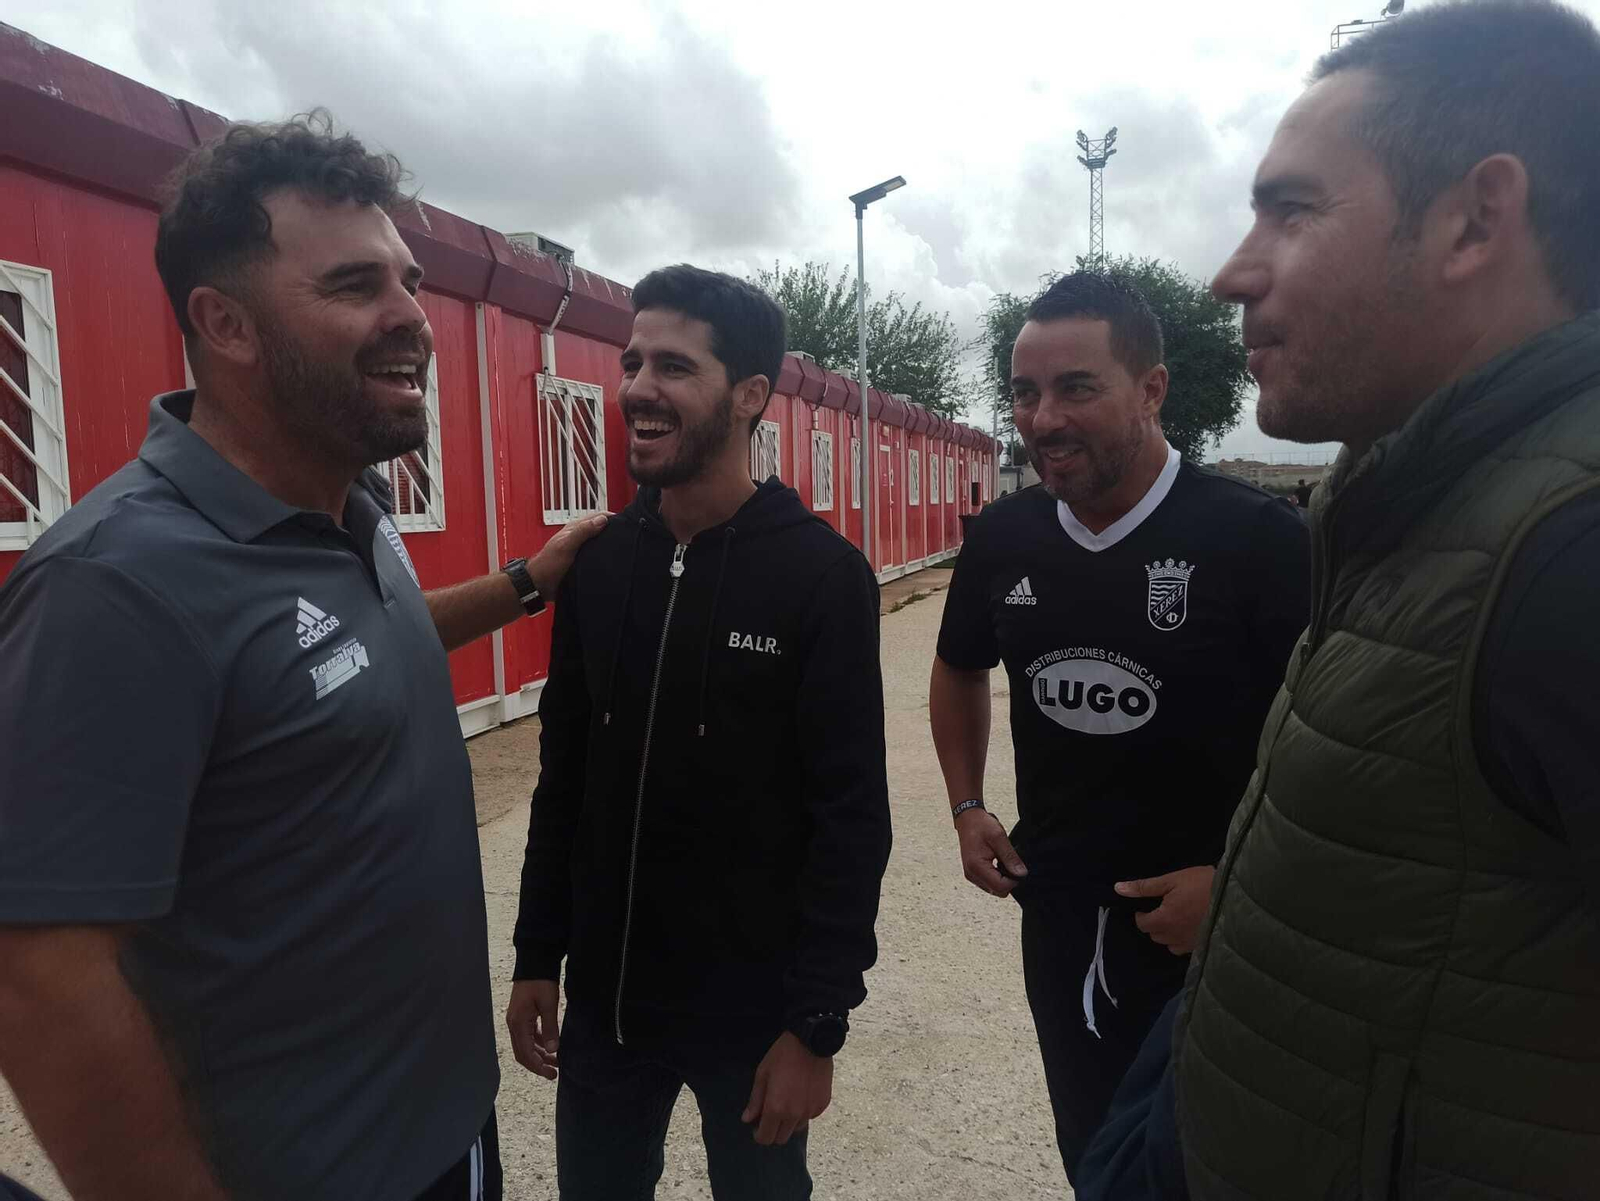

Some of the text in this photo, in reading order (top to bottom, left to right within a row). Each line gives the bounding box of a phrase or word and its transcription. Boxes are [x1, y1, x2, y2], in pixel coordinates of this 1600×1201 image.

[1005, 593, 1037, 606] adidas
[1153, 584, 1184, 618] XEREZ
[299, 615, 340, 648] adidas
[1025, 647, 1163, 690] DISTRIBUCIONES CÁRNICAS
[1038, 678, 1151, 717] LUGO
